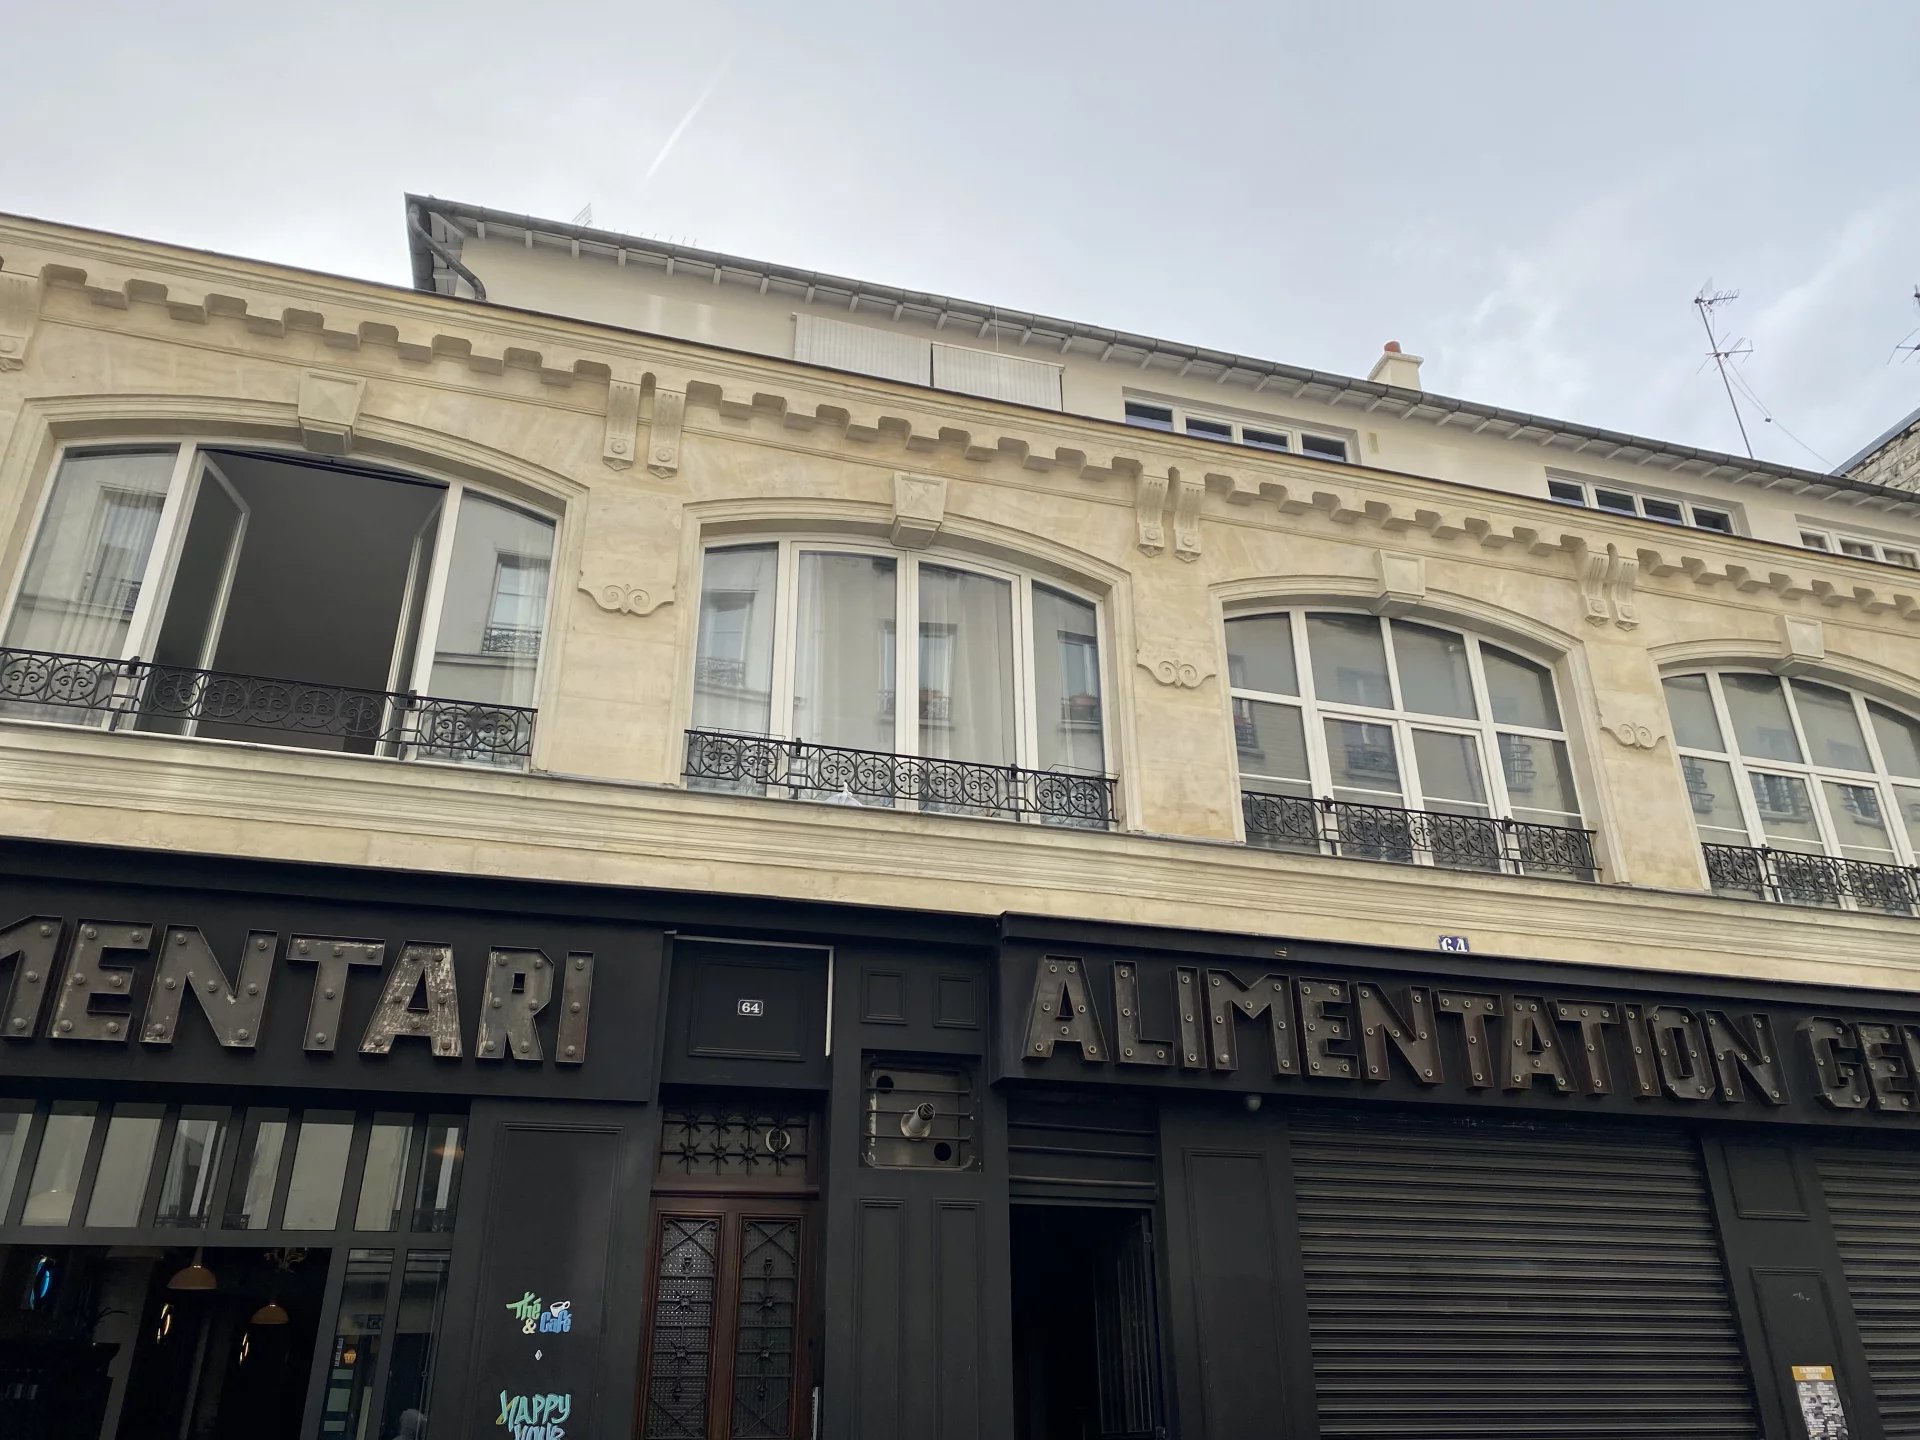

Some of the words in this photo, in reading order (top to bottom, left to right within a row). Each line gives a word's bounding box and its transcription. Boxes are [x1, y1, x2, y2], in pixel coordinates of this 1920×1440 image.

[1441, 937, 1468, 952] 64
[741, 1002, 760, 1014] 64
[1021, 953, 1791, 1105] ALIMENTATION
[1796, 1015, 1920, 1114] GE
[506, 1291, 542, 1321] Thé
[522, 1318, 537, 1334] &
[540, 1310, 572, 1333] Café
[495, 1390, 572, 1432] HAPPY
